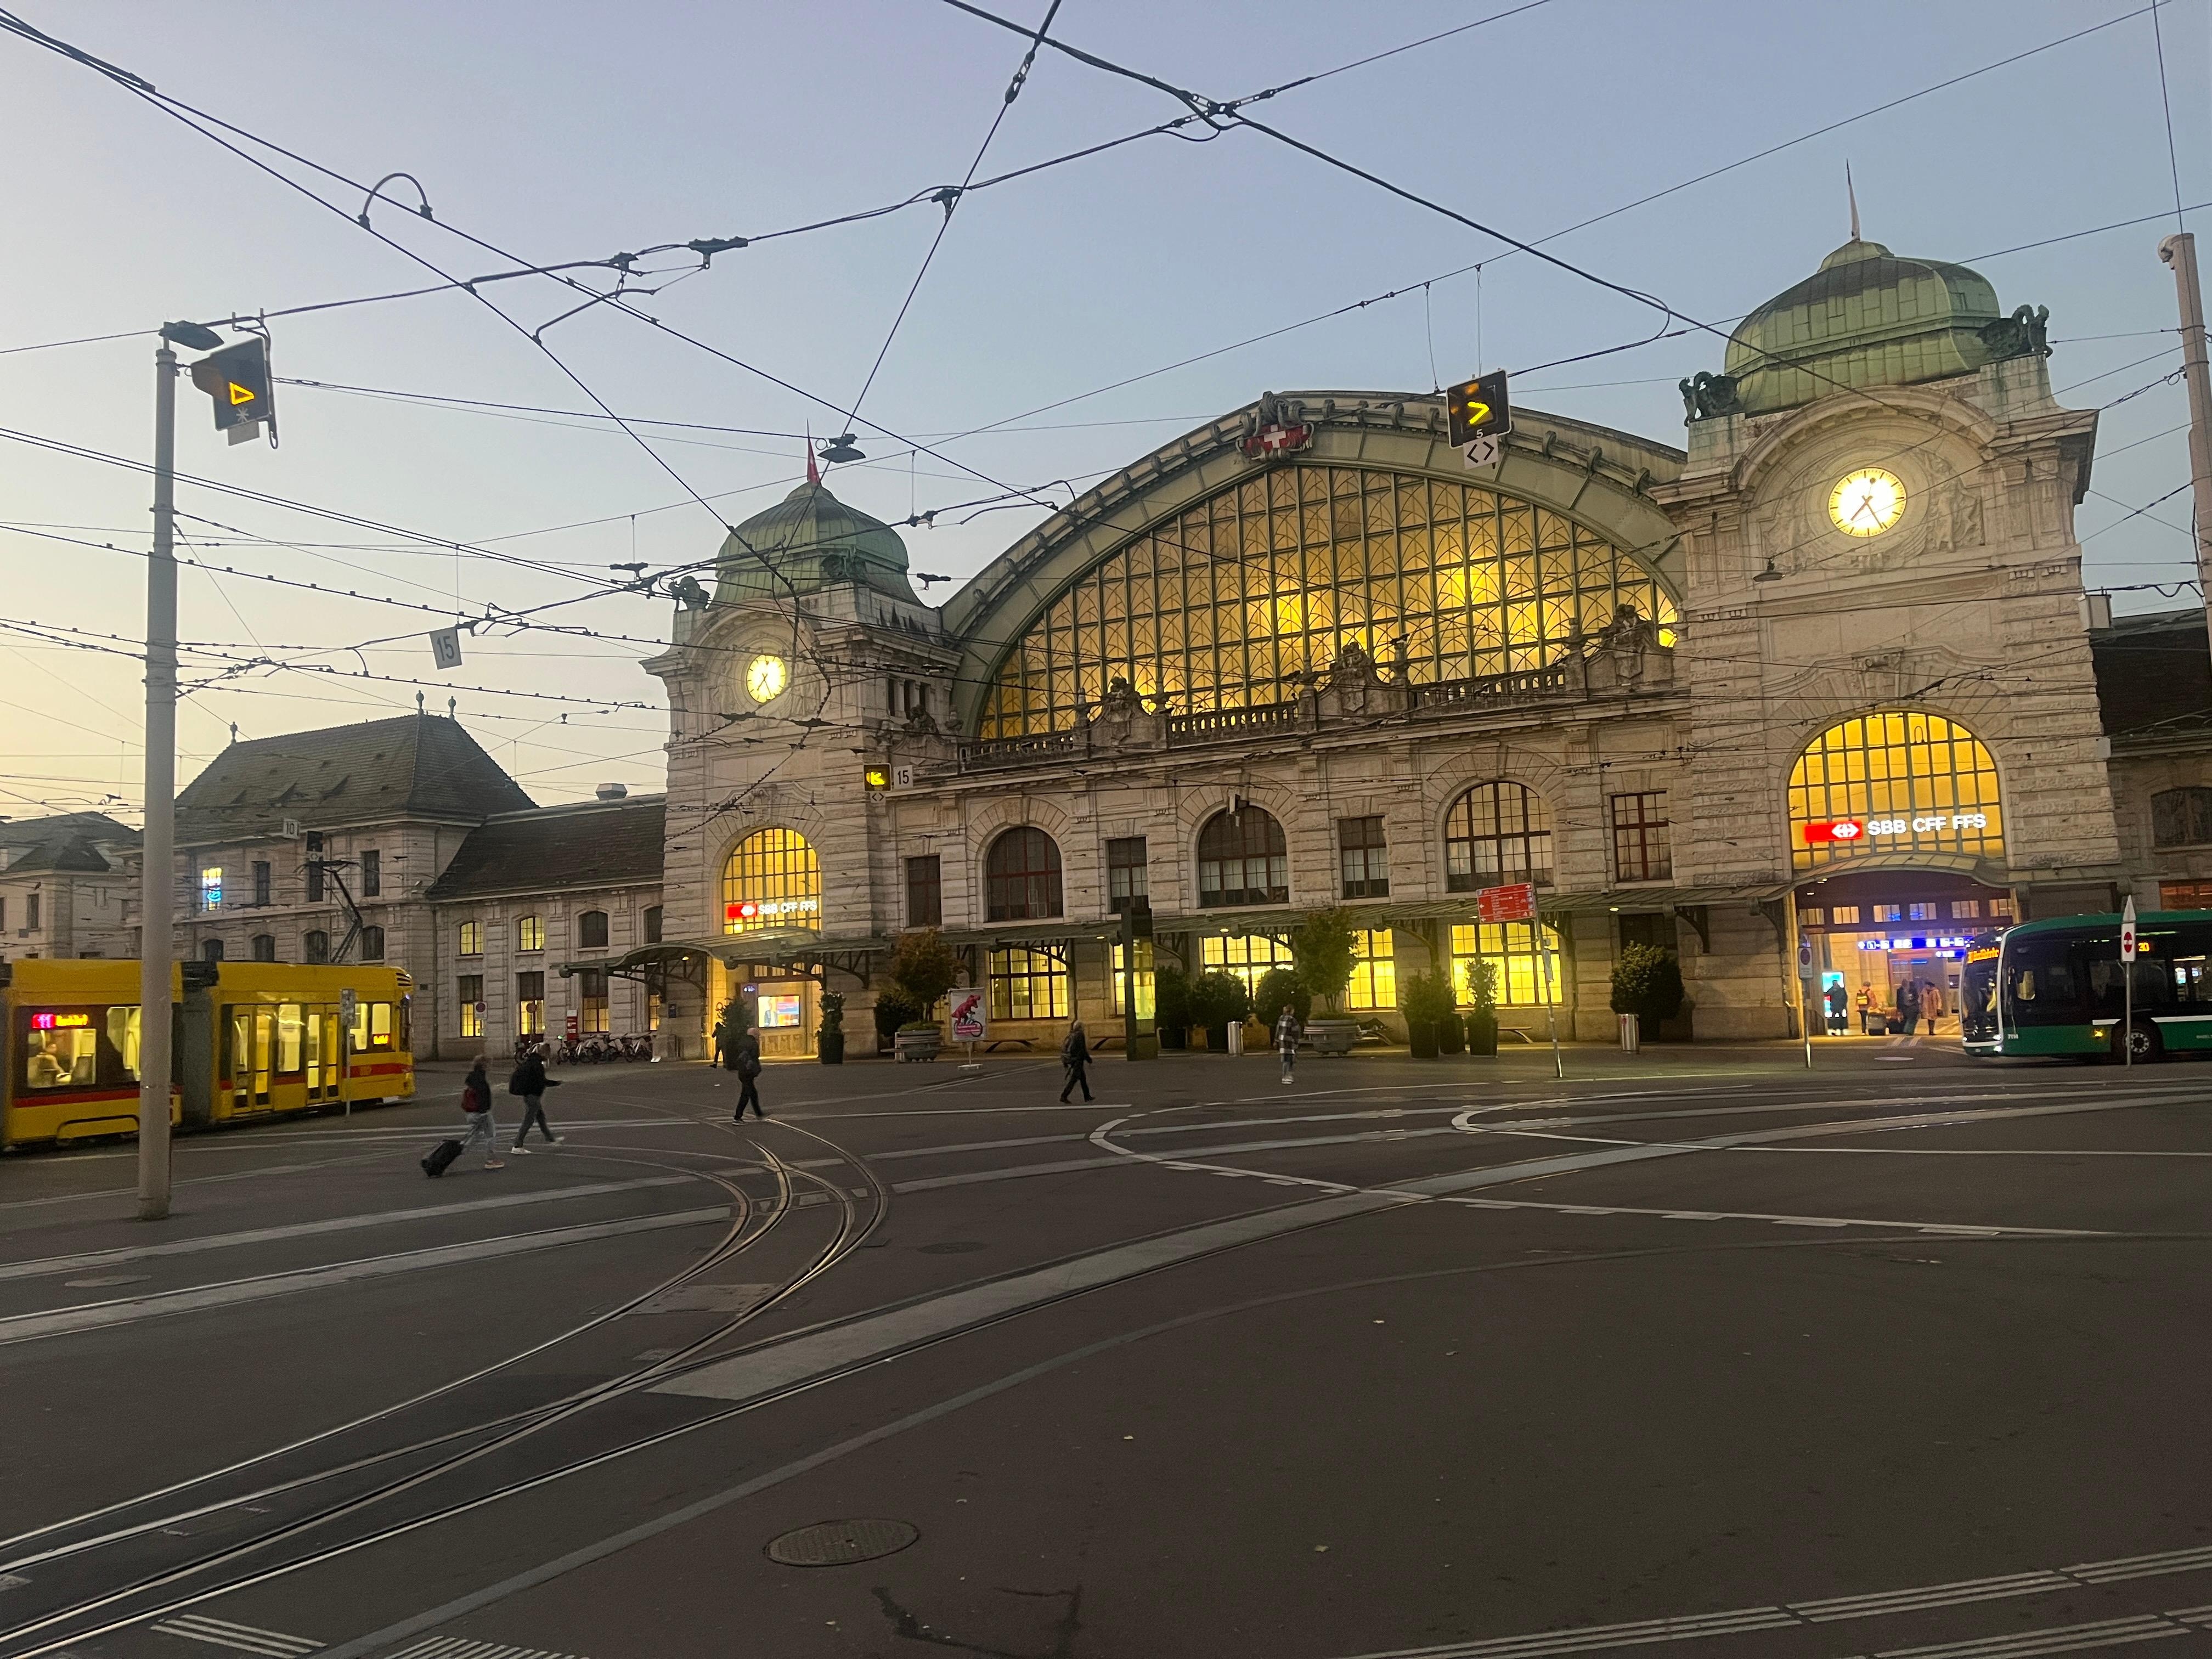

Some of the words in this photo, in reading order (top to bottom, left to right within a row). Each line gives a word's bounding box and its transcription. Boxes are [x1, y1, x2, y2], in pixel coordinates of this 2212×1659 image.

[1476, 428, 1484, 438] 5
[436, 635, 455, 662] 15
[898, 770, 910, 785] 15
[1867, 820, 1906, 836] SBB
[1912, 816, 1947, 833] CFF
[1952, 813, 1987, 830] FFS
[758, 903, 778, 915] SBB
[780, 901, 798, 914] CFF
[799, 900, 818, 912] FFS
[2138, 943, 2149, 952] 30
